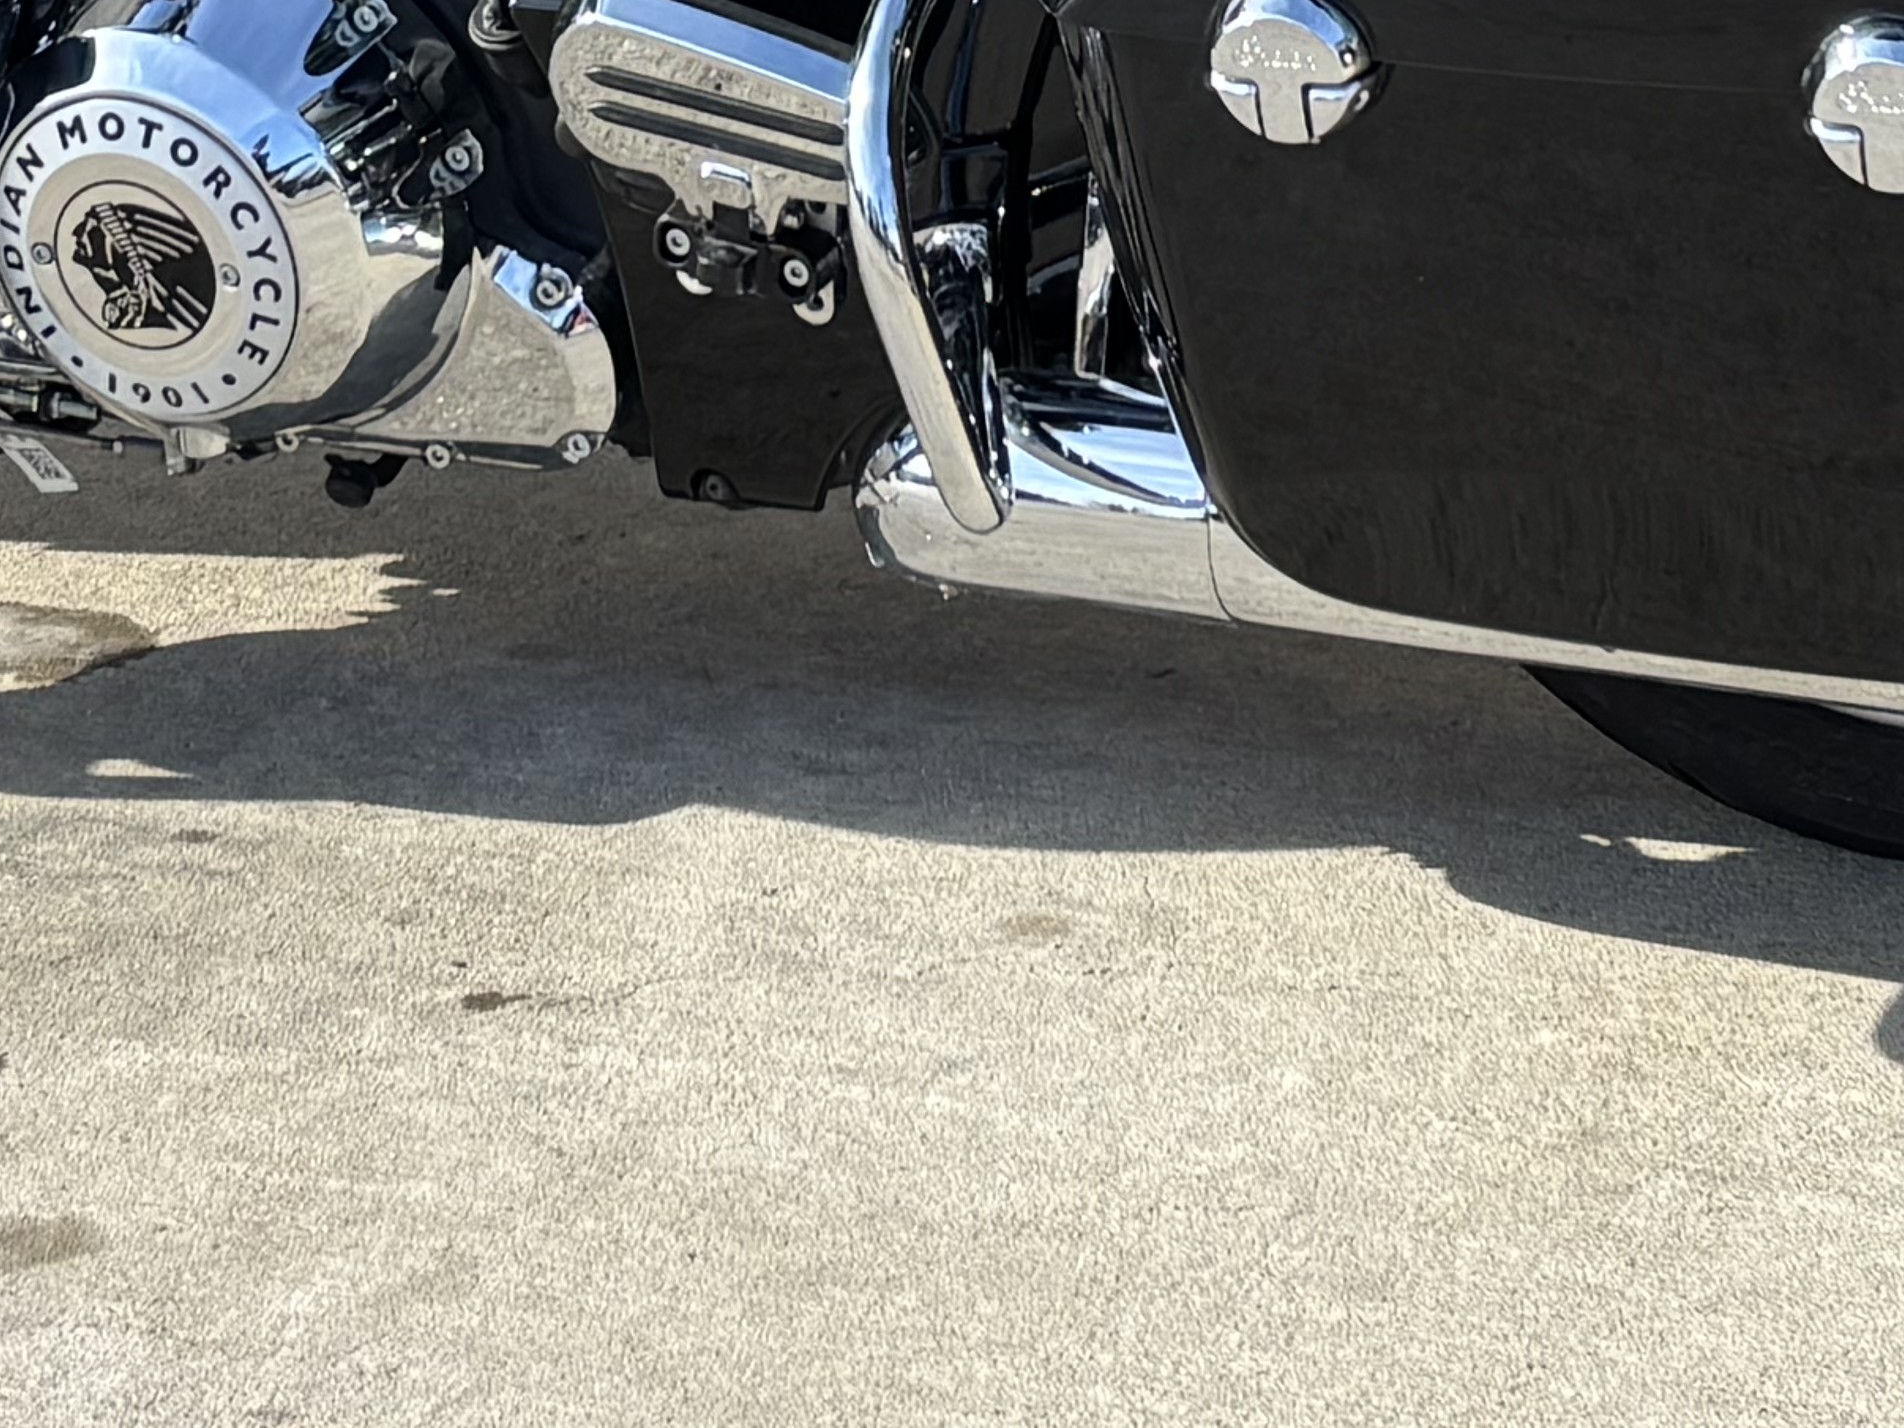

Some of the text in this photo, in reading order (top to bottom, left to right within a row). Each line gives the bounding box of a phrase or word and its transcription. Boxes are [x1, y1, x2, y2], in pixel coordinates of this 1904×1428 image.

[0, 111, 283, 366] INDIAN MOTORCYCLE
[107, 372, 210, 409] 1901
